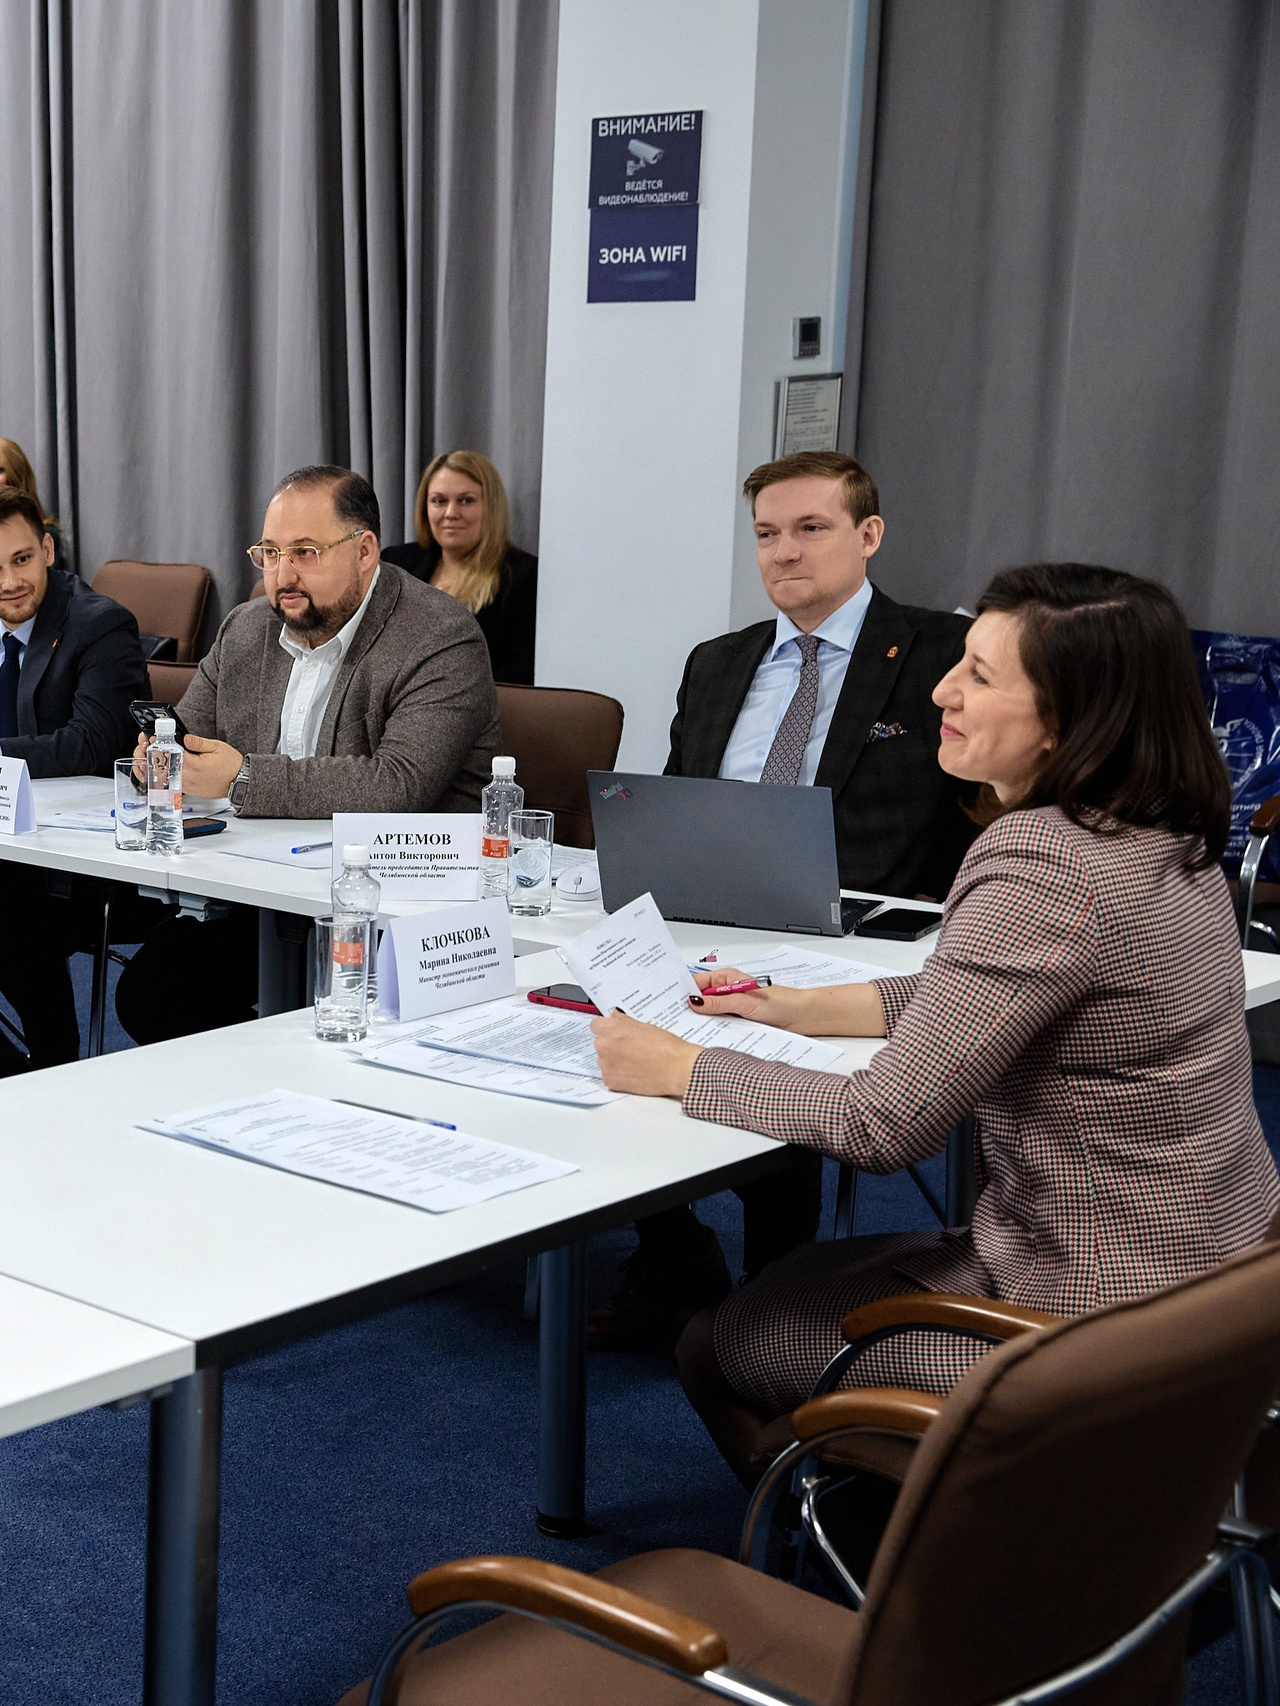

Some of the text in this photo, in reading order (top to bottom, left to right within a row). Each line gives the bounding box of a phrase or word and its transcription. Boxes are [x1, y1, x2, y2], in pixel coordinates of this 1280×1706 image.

[598, 113, 696, 137] ВНИМАНИЕ!
[624, 179, 663, 191] ВЕДЁТСЯ
[598, 191, 689, 205] ВИДЕОНАБЛЮДЕНИЕ!
[598, 245, 687, 264] ЗОНА WIFI
[373, 833, 452, 846] АРТЕМОВ
[399, 851, 459, 862] Викторович
[430, 864, 480, 872] Правительства
[421, 925, 491, 952] КЛОЧКОВА
[419, 947, 497, 971] Марина Николаевна
